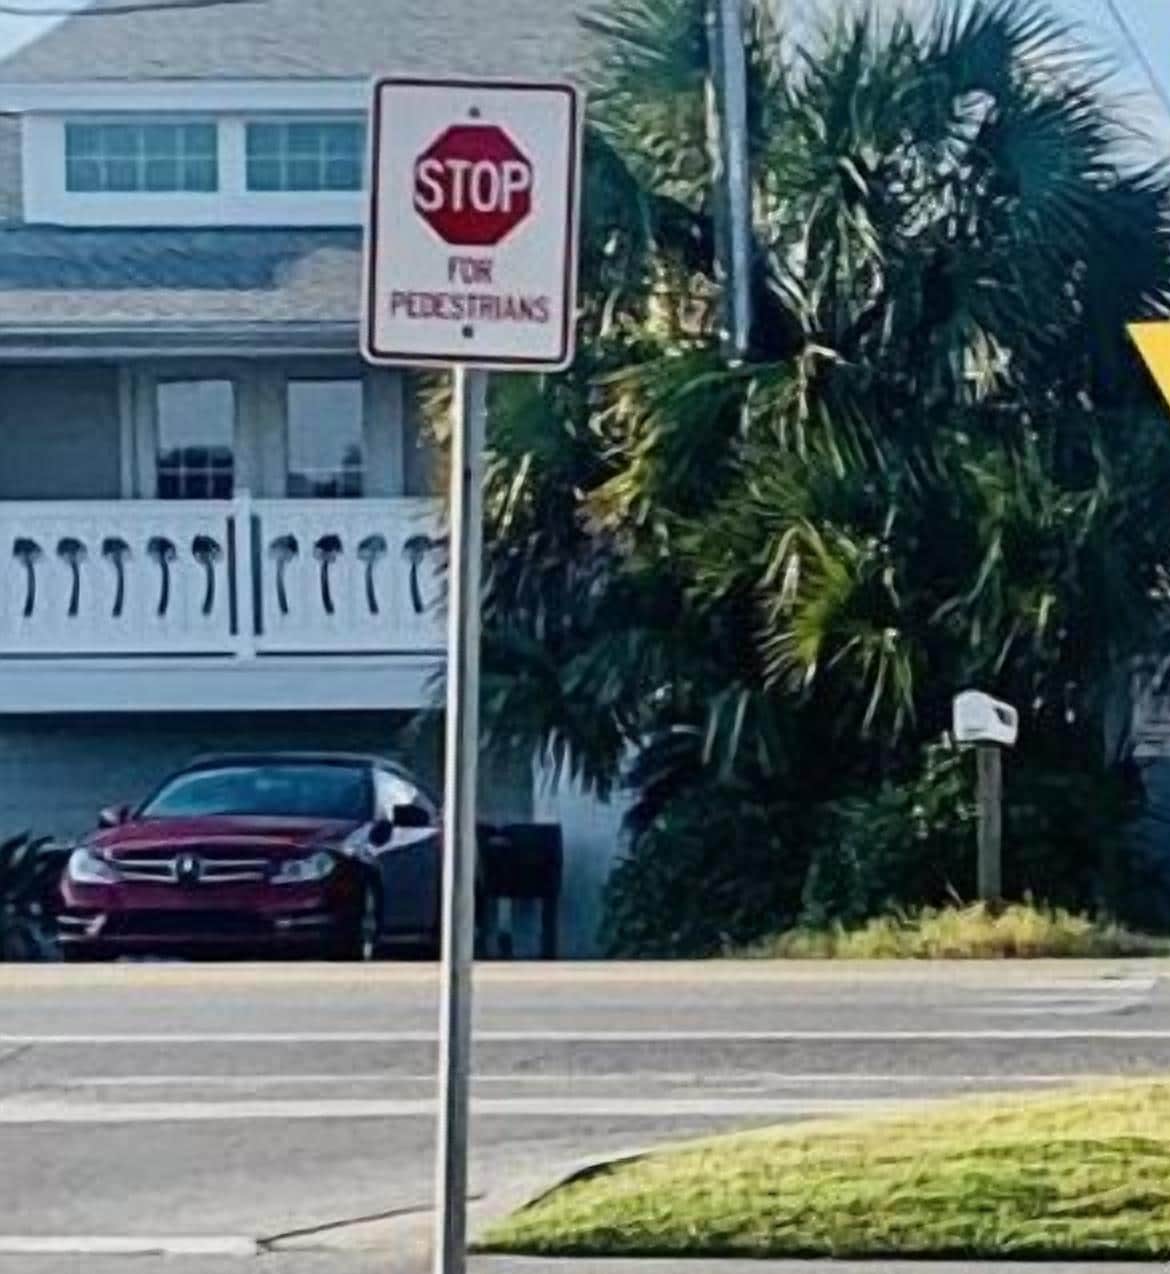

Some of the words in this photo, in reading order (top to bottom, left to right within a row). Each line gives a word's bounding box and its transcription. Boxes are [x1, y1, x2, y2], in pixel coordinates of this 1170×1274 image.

[414, 158, 531, 213] STOP
[448, 256, 493, 285] FOR
[391, 290, 549, 323] PEDESTRIANS
